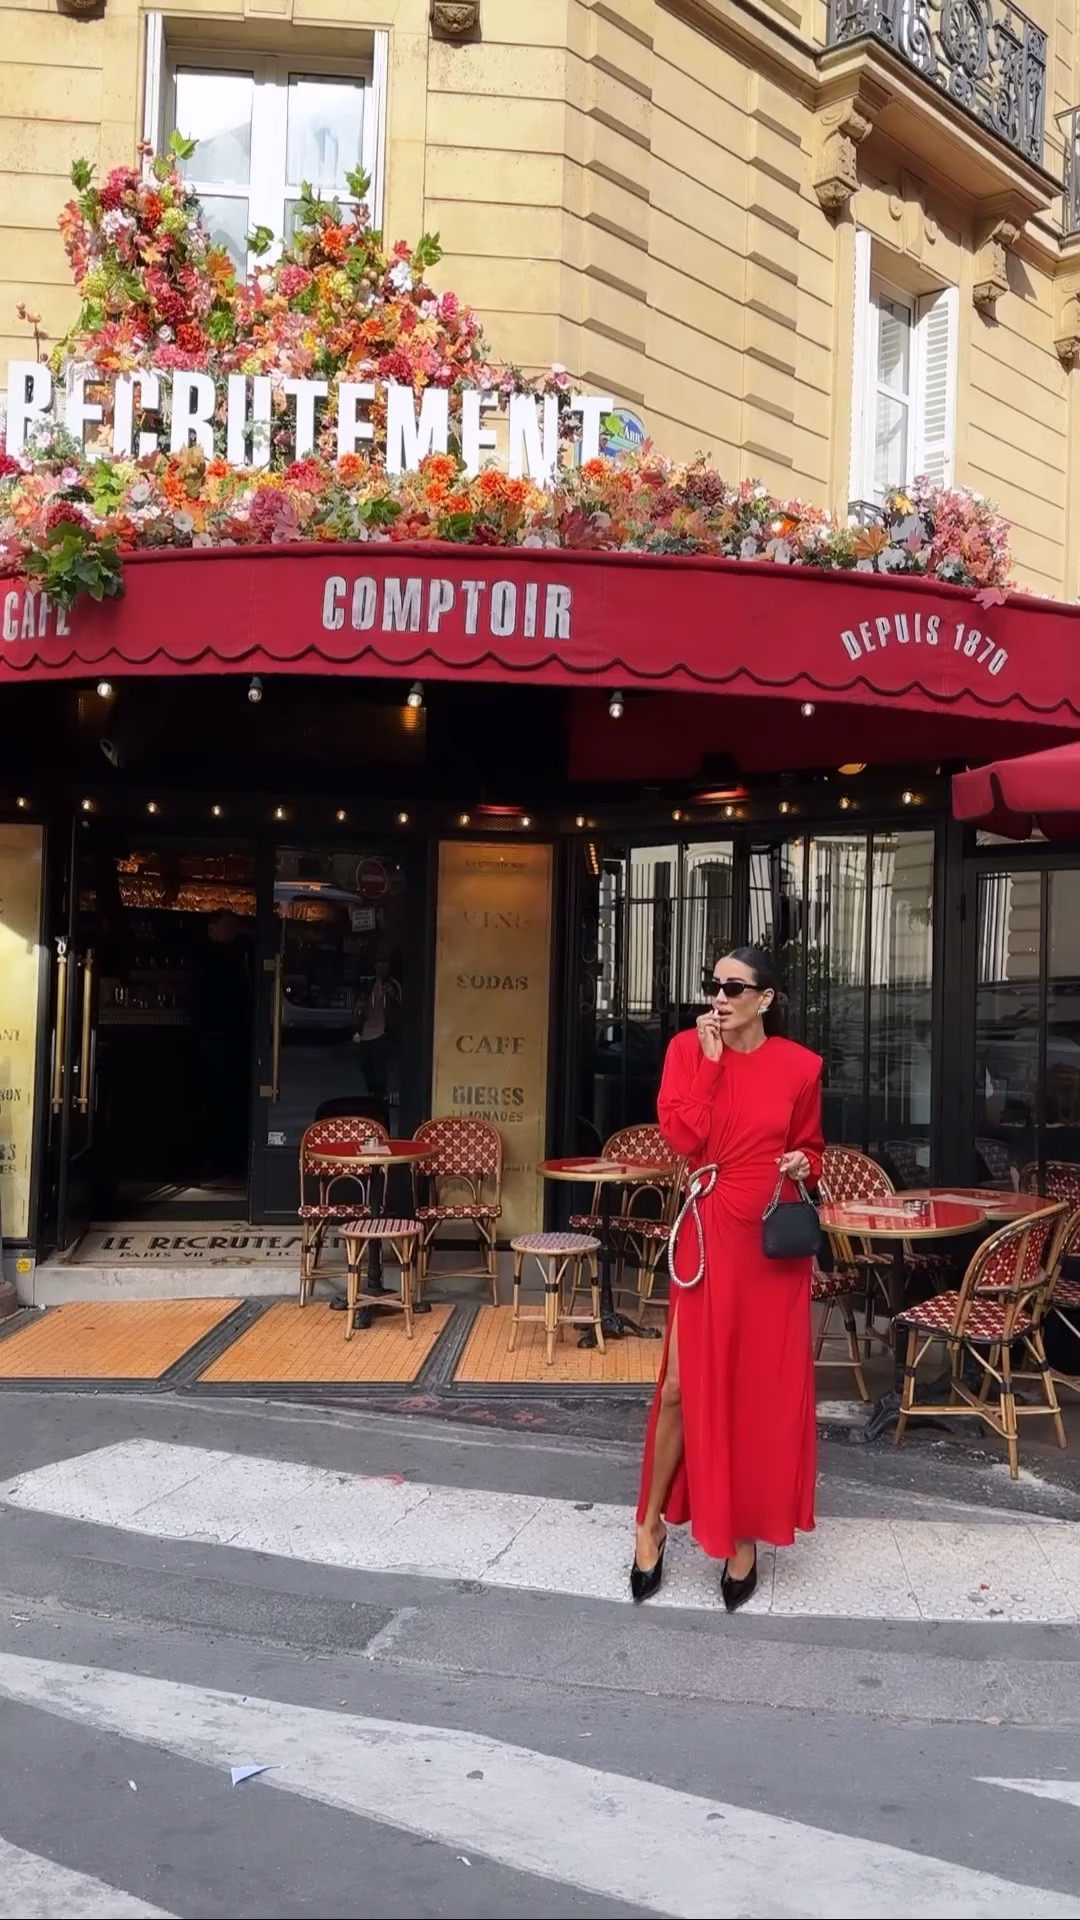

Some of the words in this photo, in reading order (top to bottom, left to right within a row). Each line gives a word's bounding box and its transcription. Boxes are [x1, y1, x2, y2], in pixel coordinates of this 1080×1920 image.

[5, 361, 614, 489] RECRUTEMENT
[322, 575, 573, 640] COMPTOIR
[840, 613, 941, 661] DEPUIS
[953, 622, 1009, 676] 1870
[456, 974, 528, 991] SODAS
[452, 1085, 525, 1106] BIERES
[102, 1236, 135, 1250] LE
